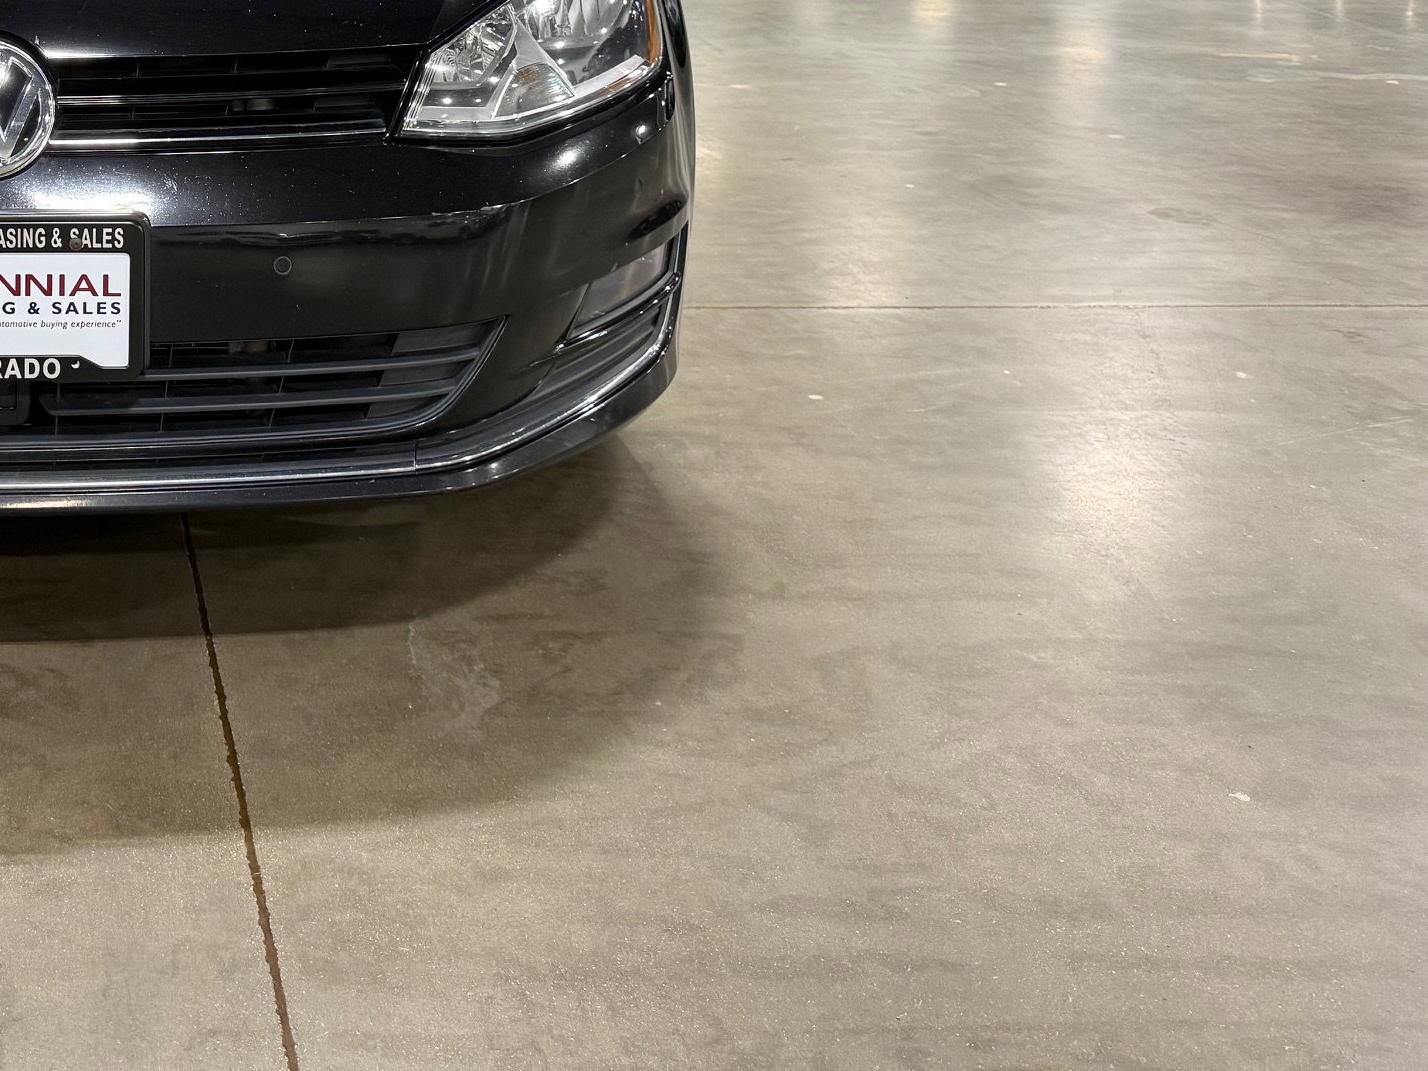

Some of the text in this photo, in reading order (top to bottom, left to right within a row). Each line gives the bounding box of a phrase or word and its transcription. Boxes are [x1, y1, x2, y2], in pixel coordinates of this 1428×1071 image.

[50, 227, 63, 249] &
[27, 301, 41, 316] &
[51, 301, 122, 316] SALES
[40, 319, 68, 330] buying
